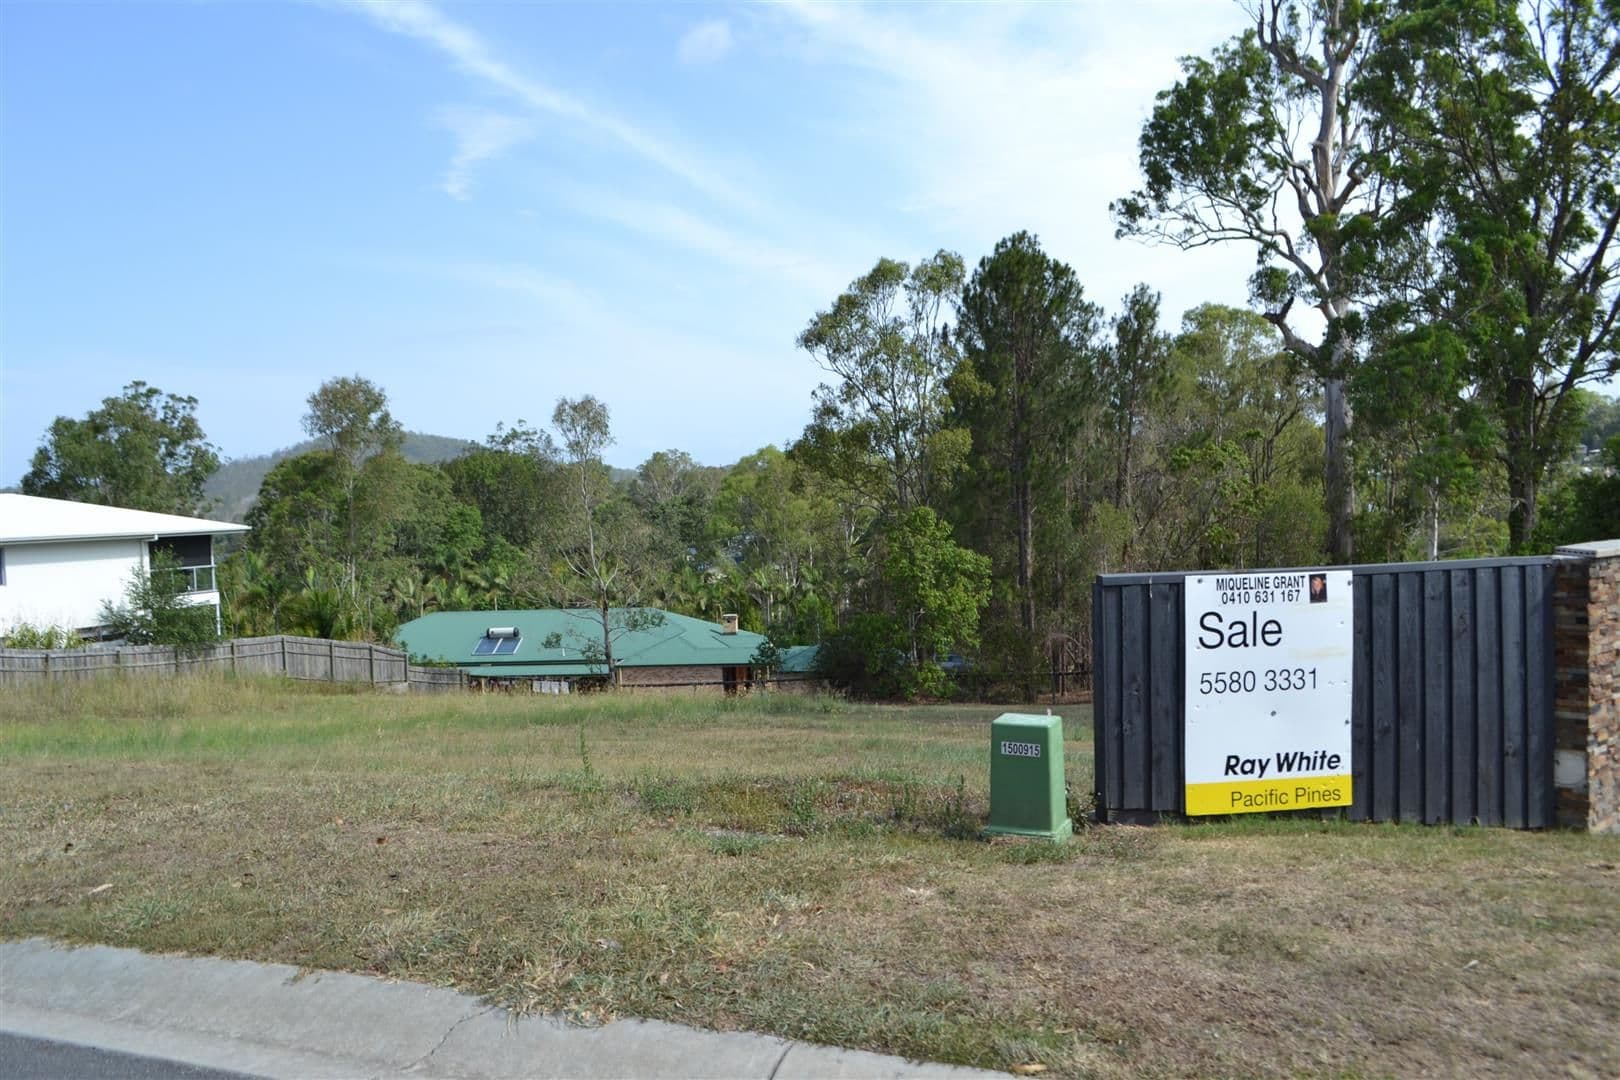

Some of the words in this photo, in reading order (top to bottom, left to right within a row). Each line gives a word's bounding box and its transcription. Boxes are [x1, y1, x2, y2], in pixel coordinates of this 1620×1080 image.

[1216, 577, 1269, 591] MIQUELINE
[1273, 575, 1305, 589] GRANT
[1221, 591, 1250, 605] 0410
[1254, 590, 1274, 604] 631
[1281, 589, 1300, 602] 167
[1198, 611, 1282, 650] Sale
[1199, 671, 1256, 695] 5580
[1264, 667, 1316, 692] 3331
[1002, 743, 1040, 756] 1500915
[1224, 755, 1271, 779] Ray
[1276, 750, 1341, 773] White
[1231, 788, 1289, 808] Pacific
[1295, 786, 1341, 804] Pines
